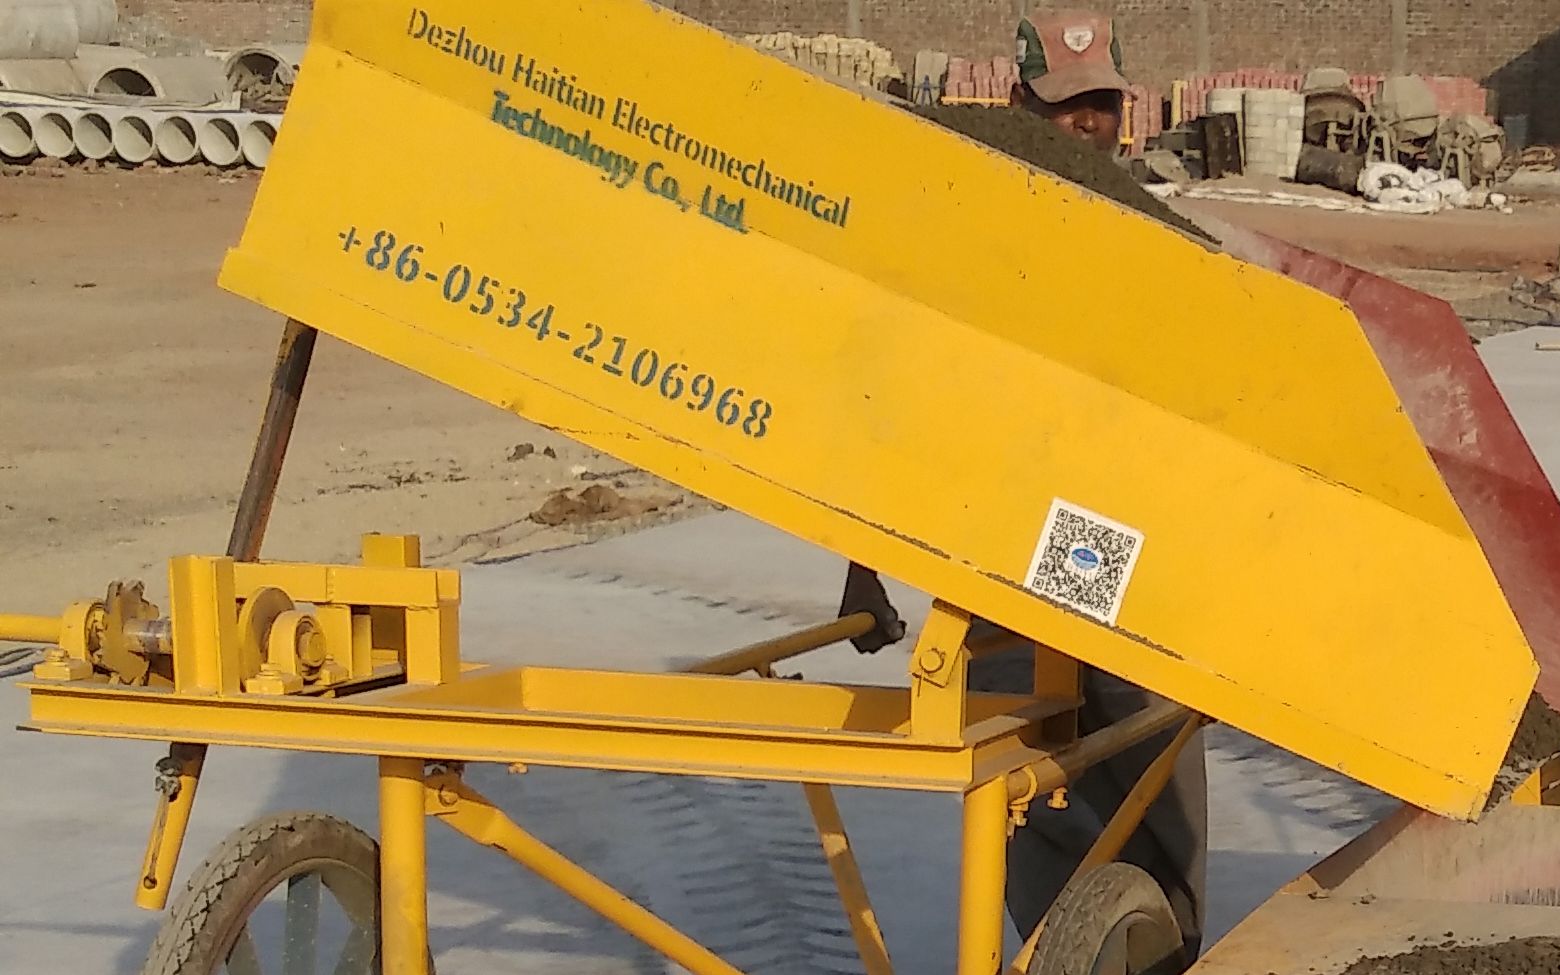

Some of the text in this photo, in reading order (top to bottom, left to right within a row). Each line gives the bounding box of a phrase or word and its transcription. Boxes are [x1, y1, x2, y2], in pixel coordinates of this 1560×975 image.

[407, 8, 851, 229] Dezhou Haitian Electromechanical
[491, 90, 639, 189] Technology
[337, 225, 772, 438] +86-0534-2106968
